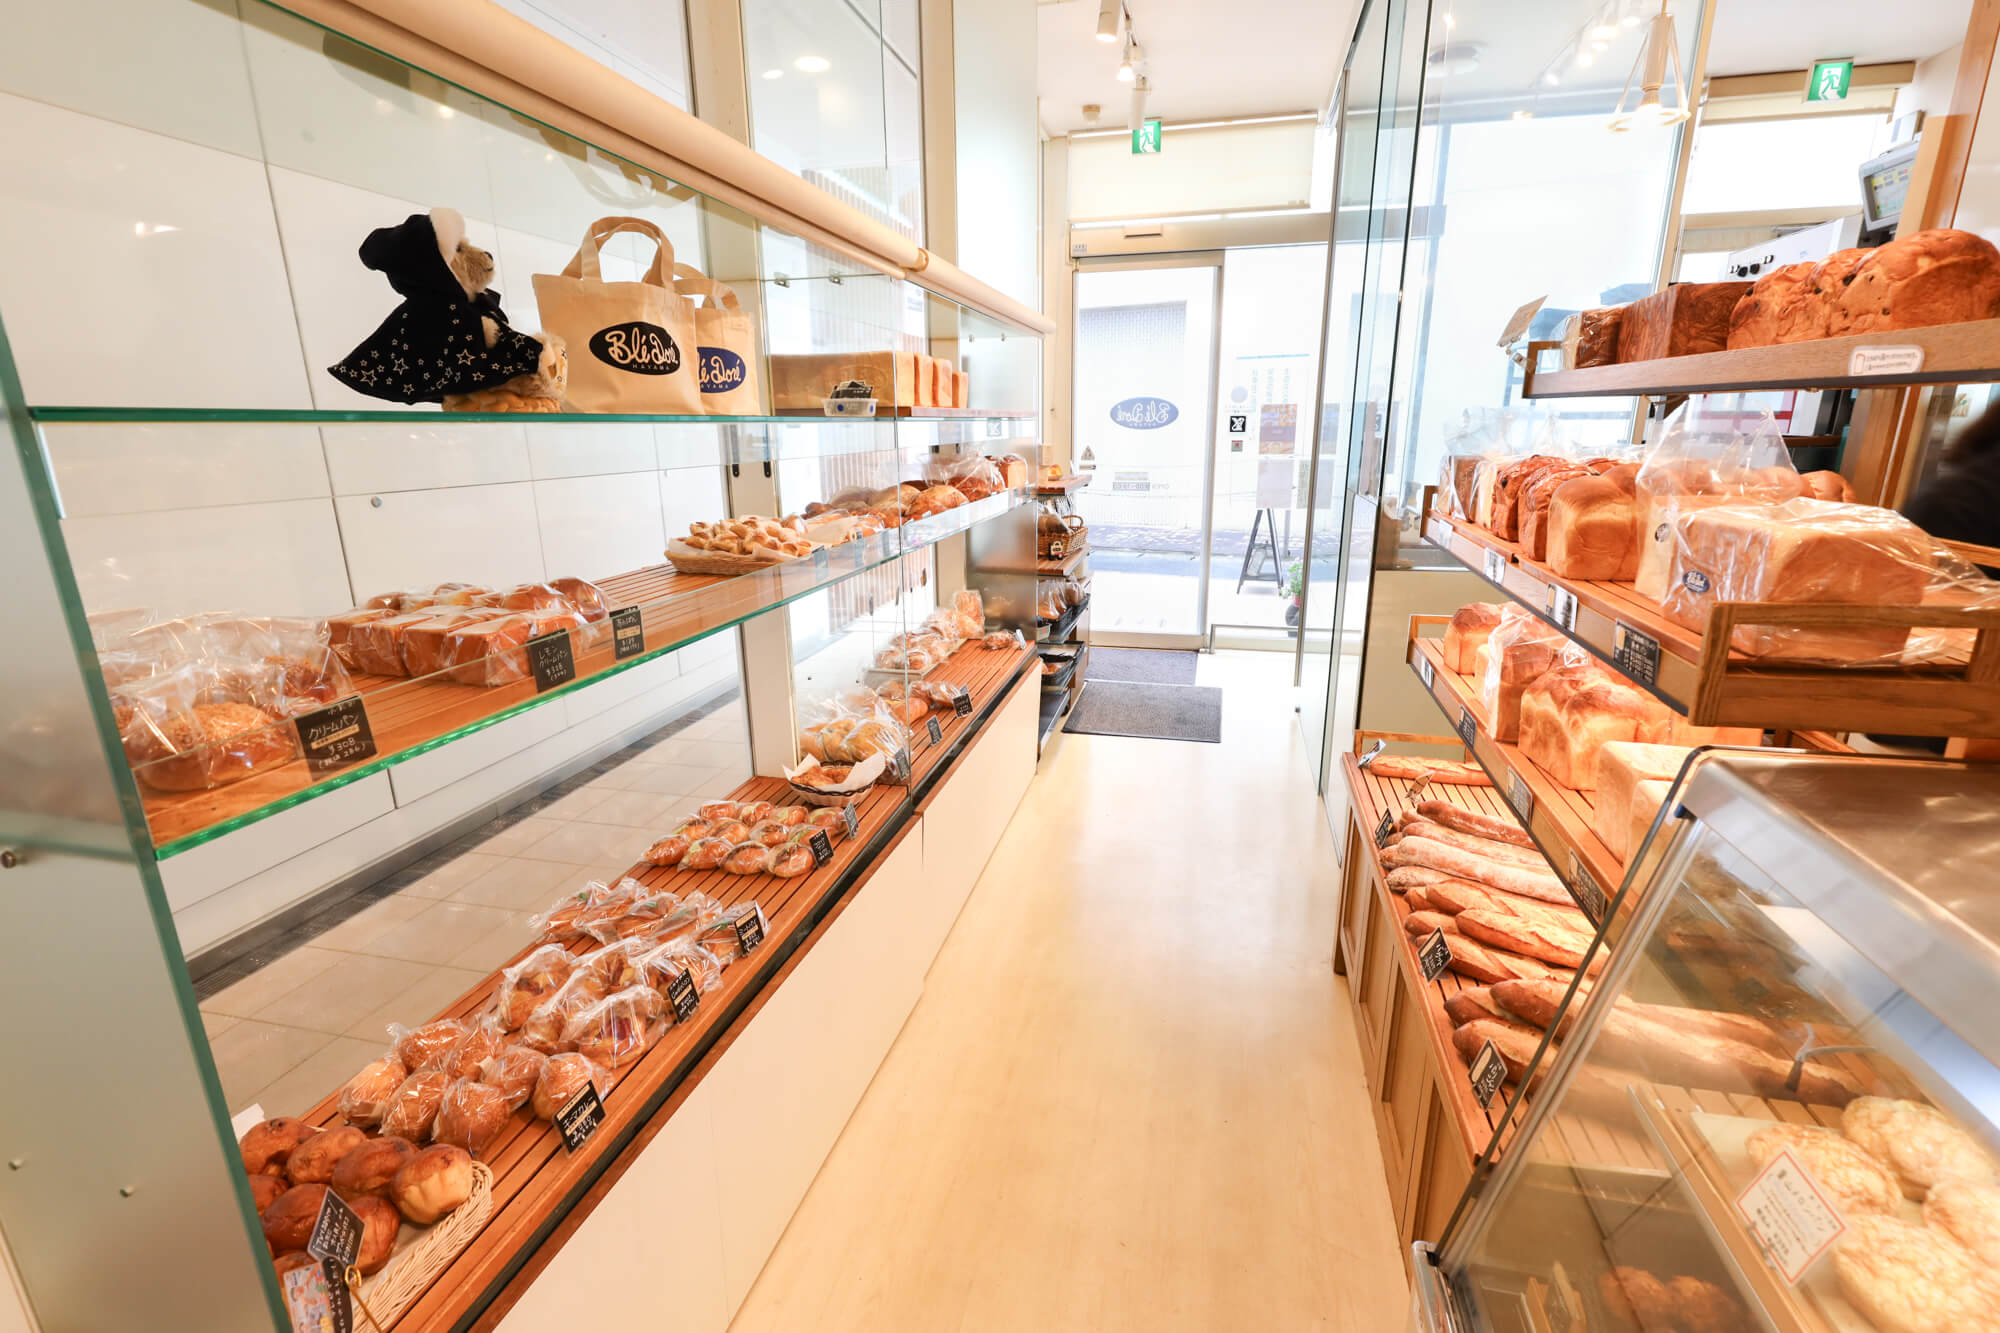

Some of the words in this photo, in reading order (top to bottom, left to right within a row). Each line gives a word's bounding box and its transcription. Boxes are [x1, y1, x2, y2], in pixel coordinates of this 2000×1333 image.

[605, 328, 650, 364] Blé
[710, 356, 742, 384] Doré
[308, 714, 360, 740] クリームパン
[563, 1096, 593, 1128] キーマカレー
